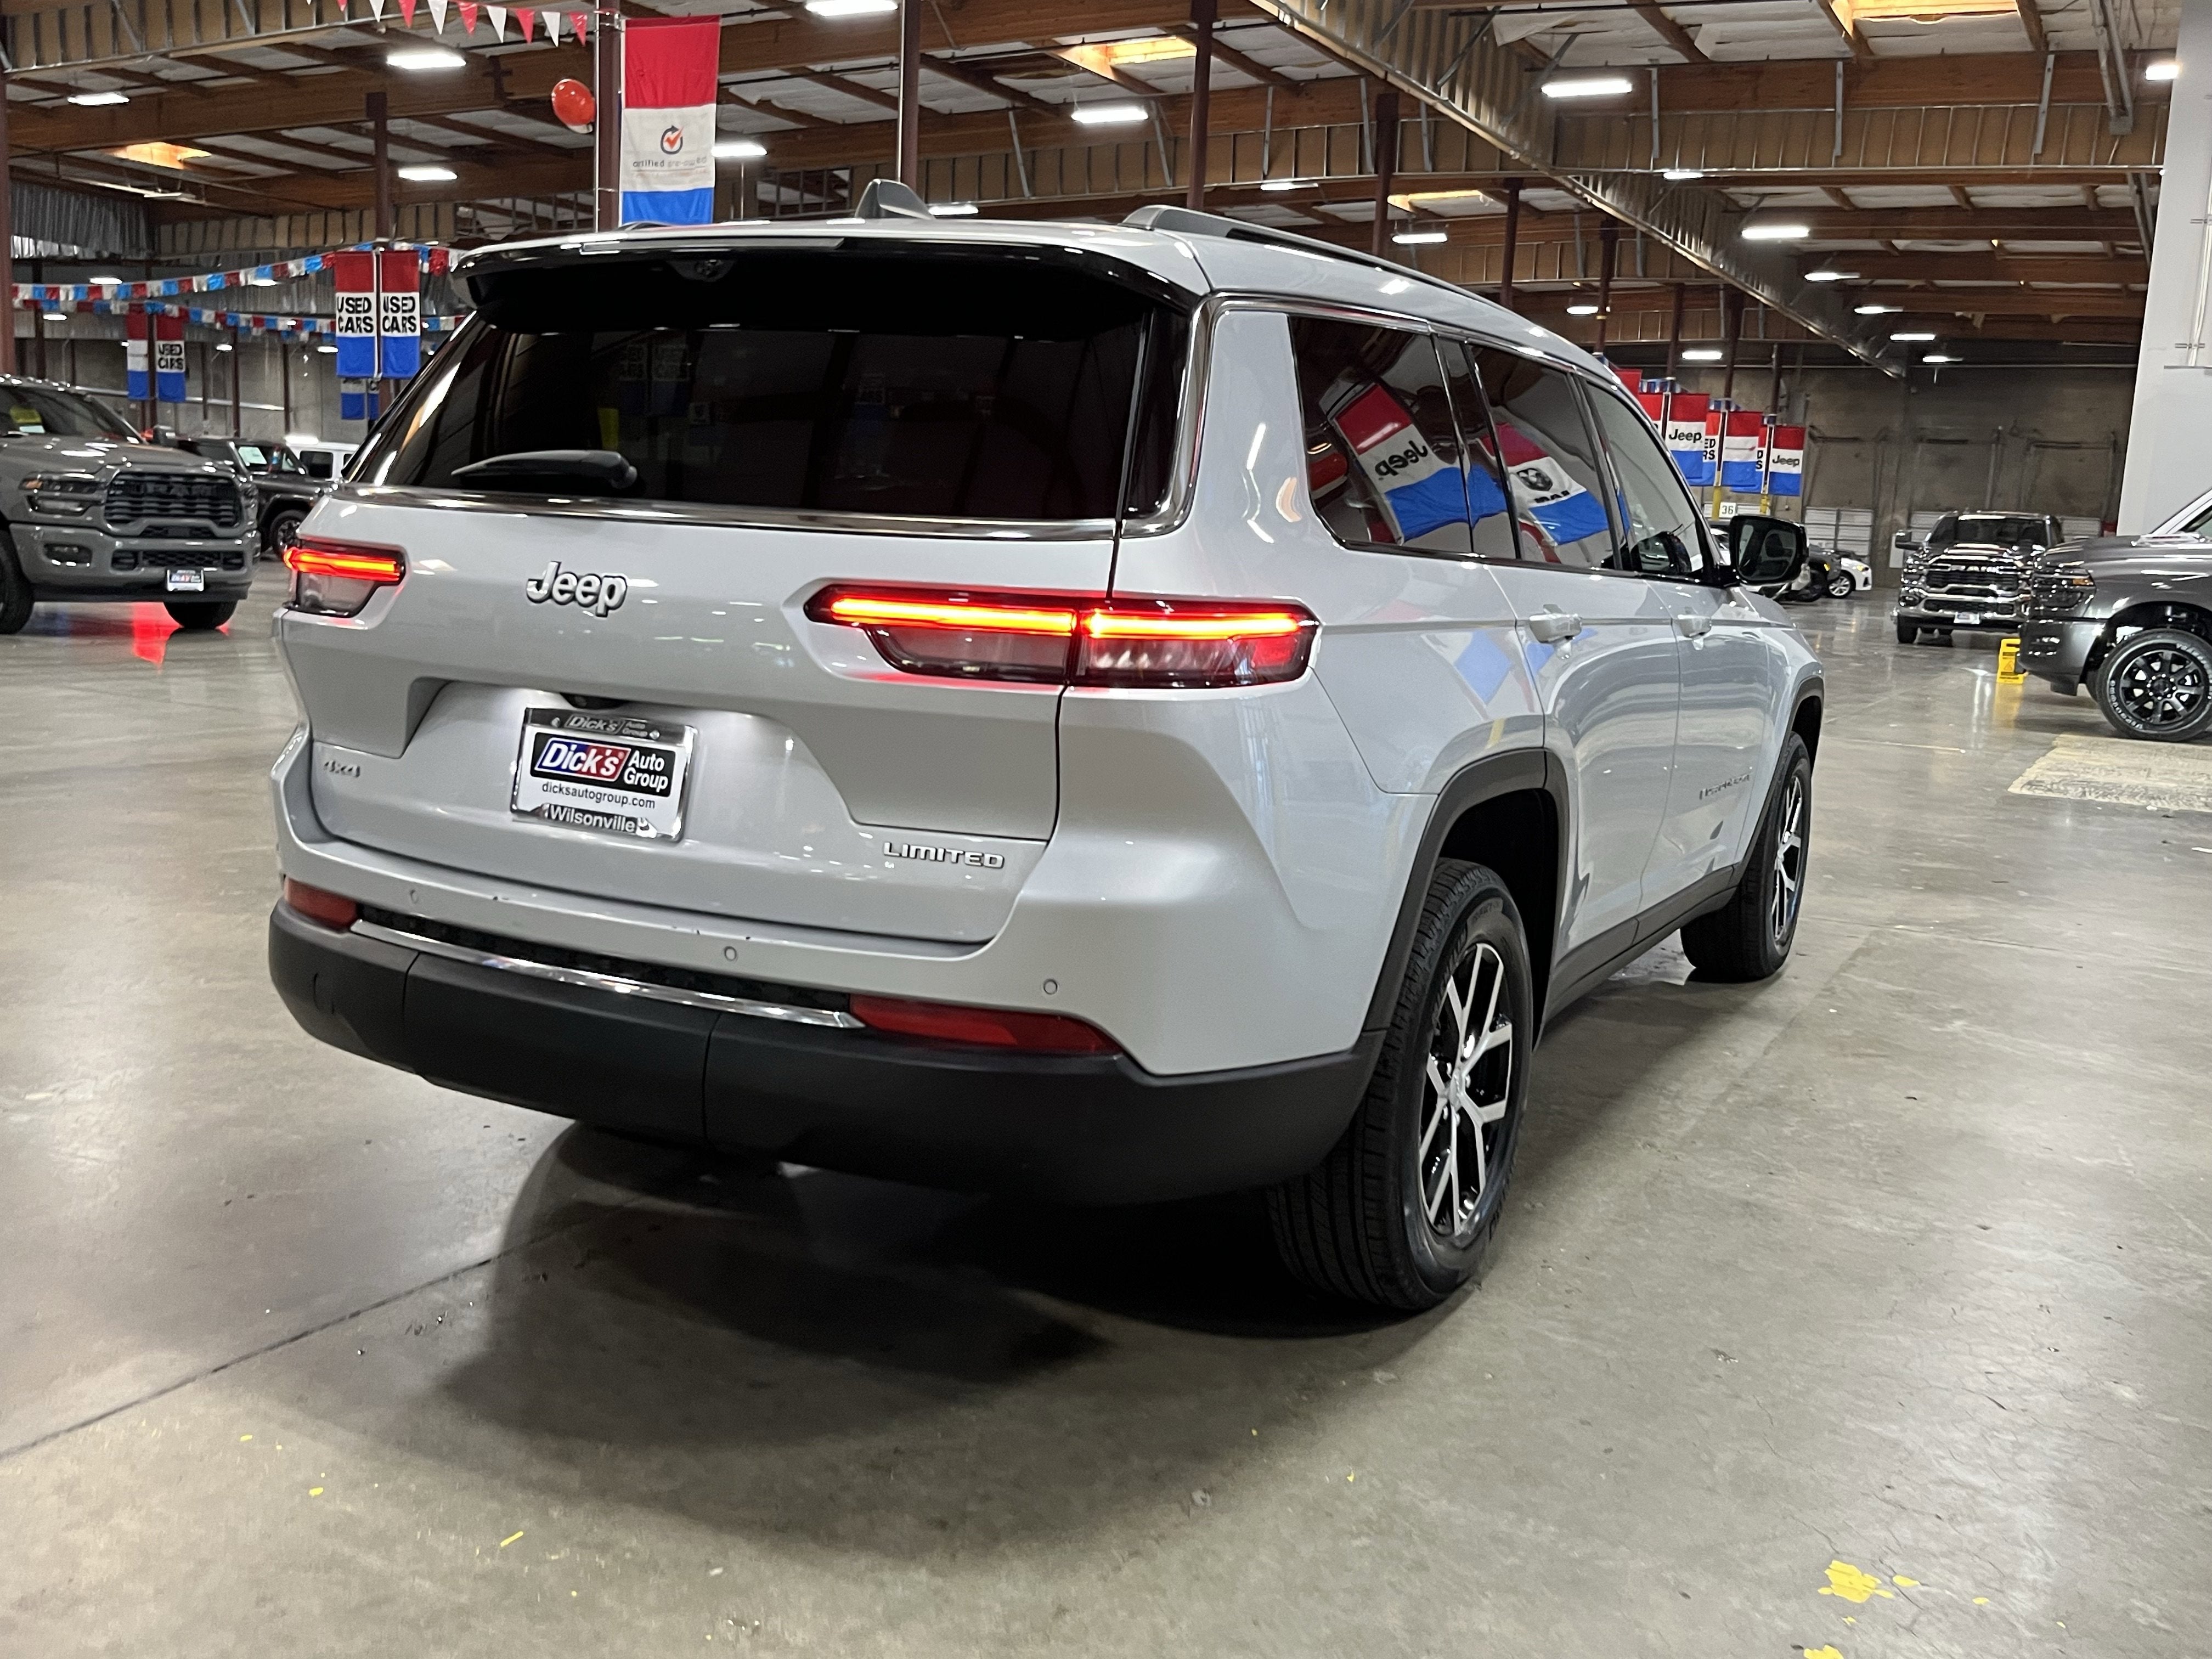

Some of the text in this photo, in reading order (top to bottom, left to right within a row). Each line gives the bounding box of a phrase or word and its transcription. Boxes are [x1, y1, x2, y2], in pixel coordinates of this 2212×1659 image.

[337, 296, 372, 314] USED
[383, 296, 416, 314] USED
[337, 315, 374, 333] CARS
[382, 315, 417, 333] CARS
[1668, 428, 1702, 443] Jeep
[1704, 438, 1716, 449] ED
[1772, 455, 1800, 467] Jeep
[1722, 505, 1734, 515] 36
[526, 561, 628, 618] Jeep
[569, 716, 618, 732] Dick's
[541, 743, 619, 777] Dick's
[628, 749, 665, 771] Auto
[623, 768, 669, 793] Group
[541, 782, 656, 809] dicksautogroup.com
[550, 804, 636, 832] Wilsonville
[883, 842, 1005, 869] LIMITED
